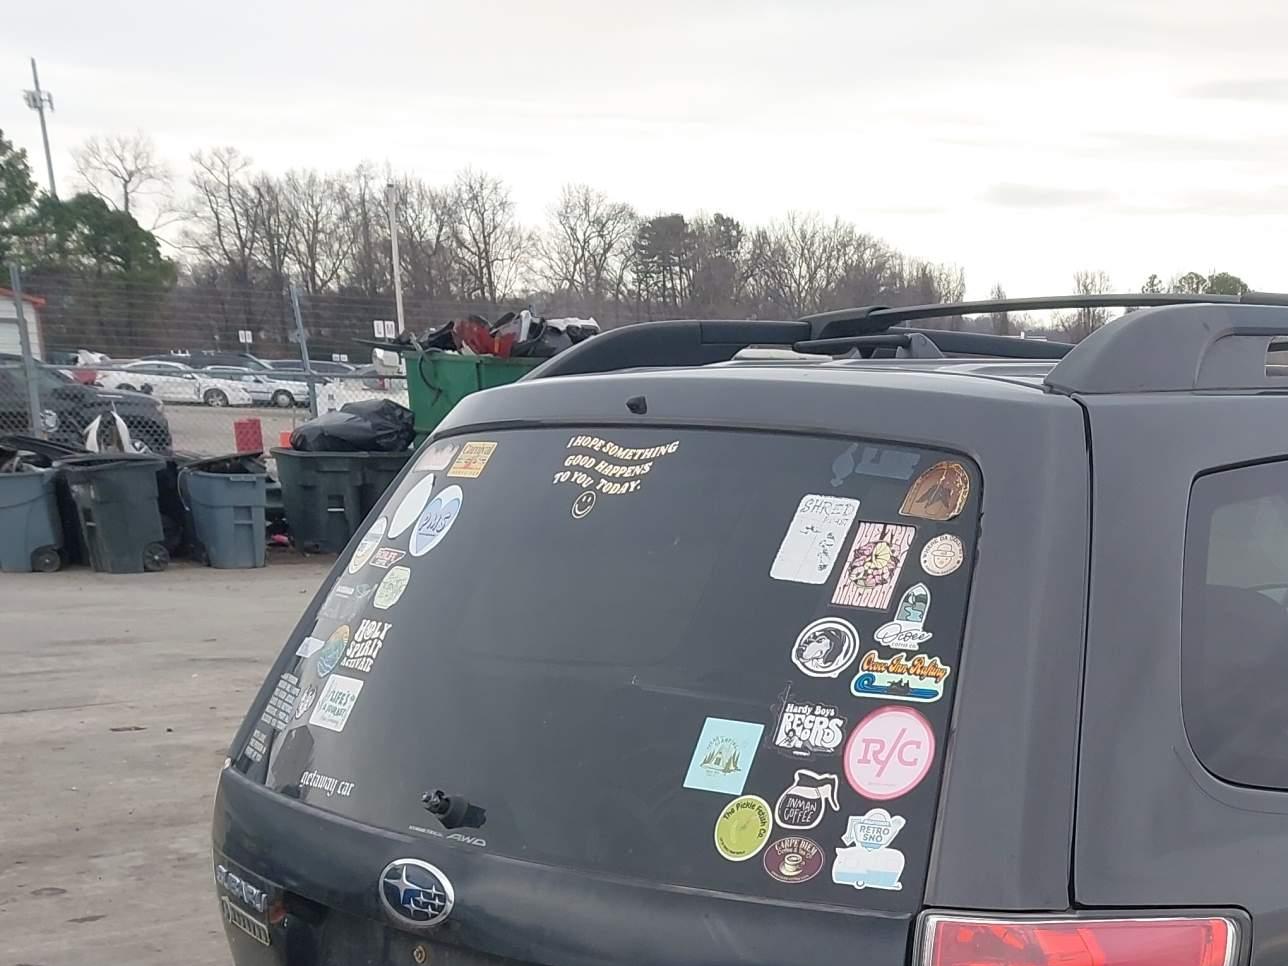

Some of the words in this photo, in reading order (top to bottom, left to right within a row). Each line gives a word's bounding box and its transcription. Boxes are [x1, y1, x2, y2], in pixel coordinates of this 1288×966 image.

[567, 437, 575, 448] I
[573, 435, 604, 451] HOPE
[602, 441, 680, 460] SOMETHING
[564, 455, 596, 469] GOOD
[595, 460, 653, 478] HAPPENS
[553, 471, 571, 484] TO
[570, 471, 594, 488] YOU
[596, 479, 641, 494] TODAY.
[800, 498, 856, 517] SHRED
[354, 619, 393, 642] HOLY
[346, 639, 382, 659] SPIRIT
[785, 704, 813, 716] Hardy
[814, 705, 835, 717] Boys
[857, 728, 921, 778] R/C
[299, 770, 338, 797] getaway
[337, 781, 355, 796] car
[723, 808, 735, 820] The
[736, 801, 756, 811] Pickle
[786, 798, 817, 812] INMAN
[784, 808, 813, 823] COFFEE
[859, 824, 890, 836] RETRO
[863, 833, 883, 843] SNO
[446, 834, 486, 847] AWD
